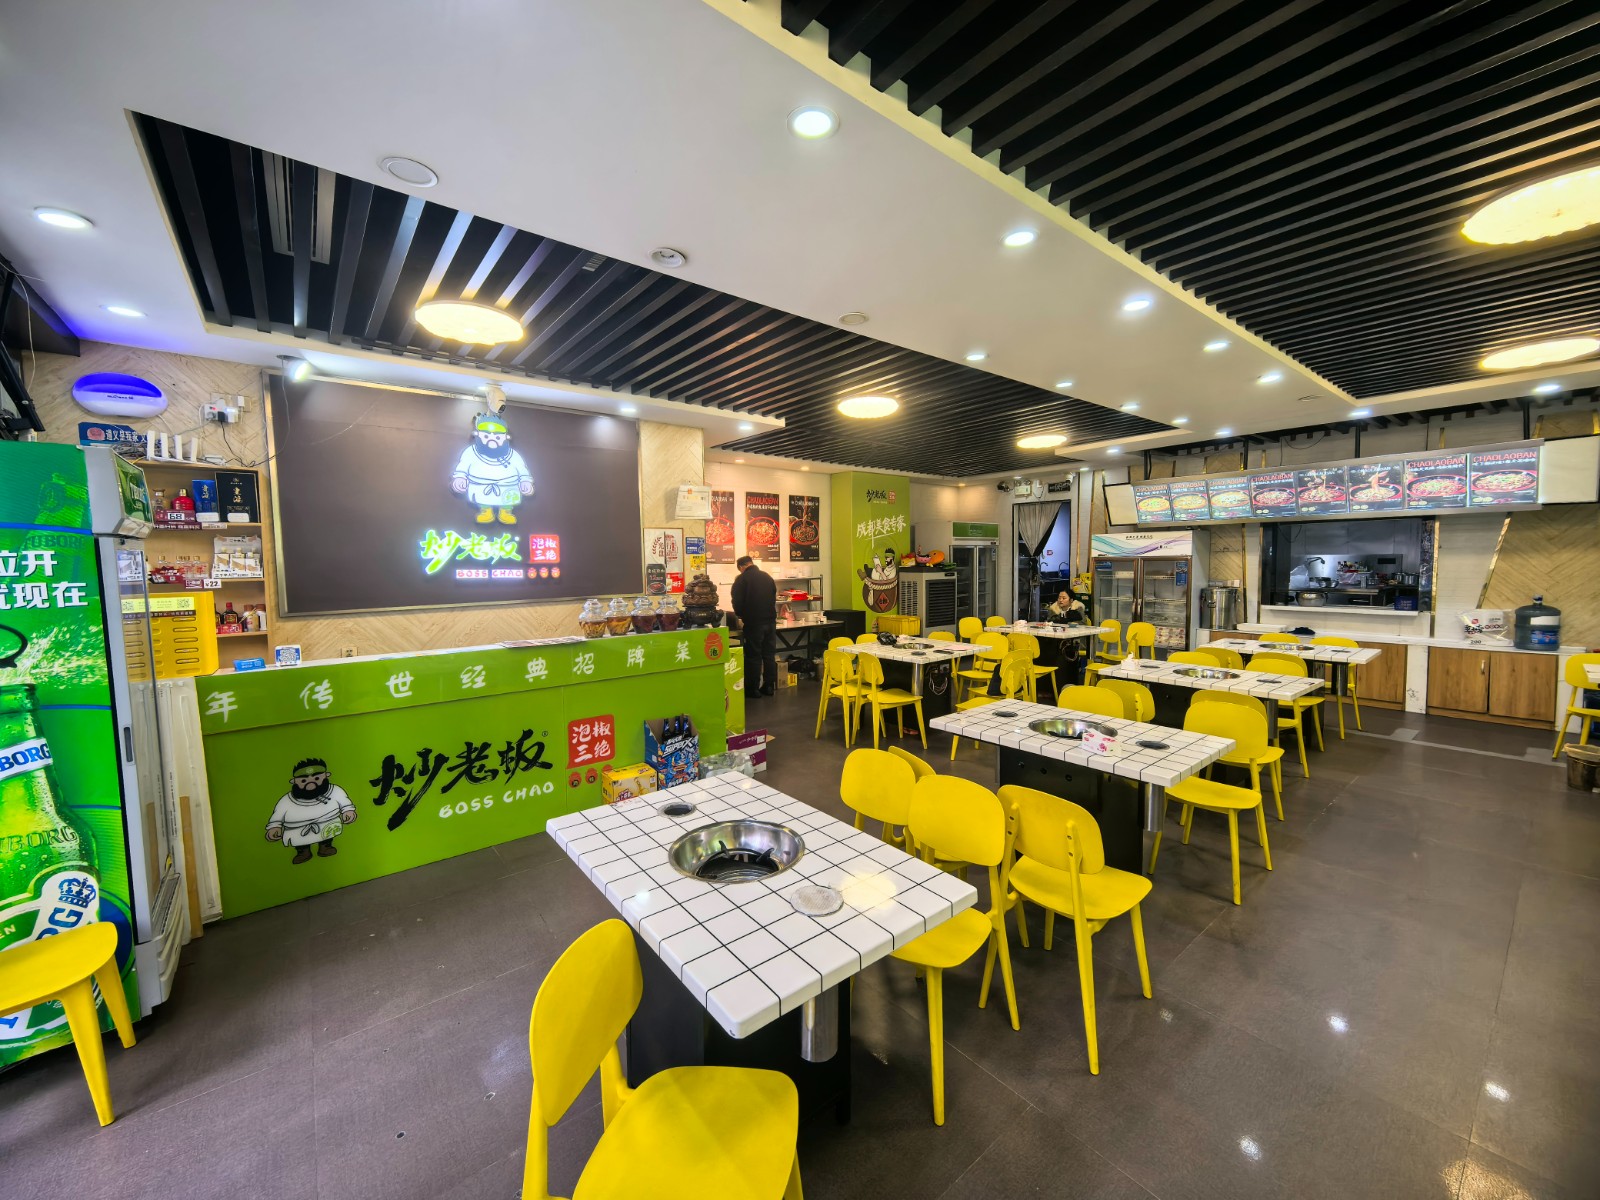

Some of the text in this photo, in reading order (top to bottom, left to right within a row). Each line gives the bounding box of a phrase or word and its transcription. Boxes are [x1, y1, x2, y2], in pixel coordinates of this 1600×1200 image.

[419, 530, 522, 575] 炒老板
[532, 537, 557, 549] 泡椒
[533, 550, 557, 560] 三绝
[572, 721, 612, 743] 泡椒
[574, 740, 611, 763] 三绝
[369, 728, 553, 832] 炒老板
[438, 781, 555, 819] BOSS CHAO
